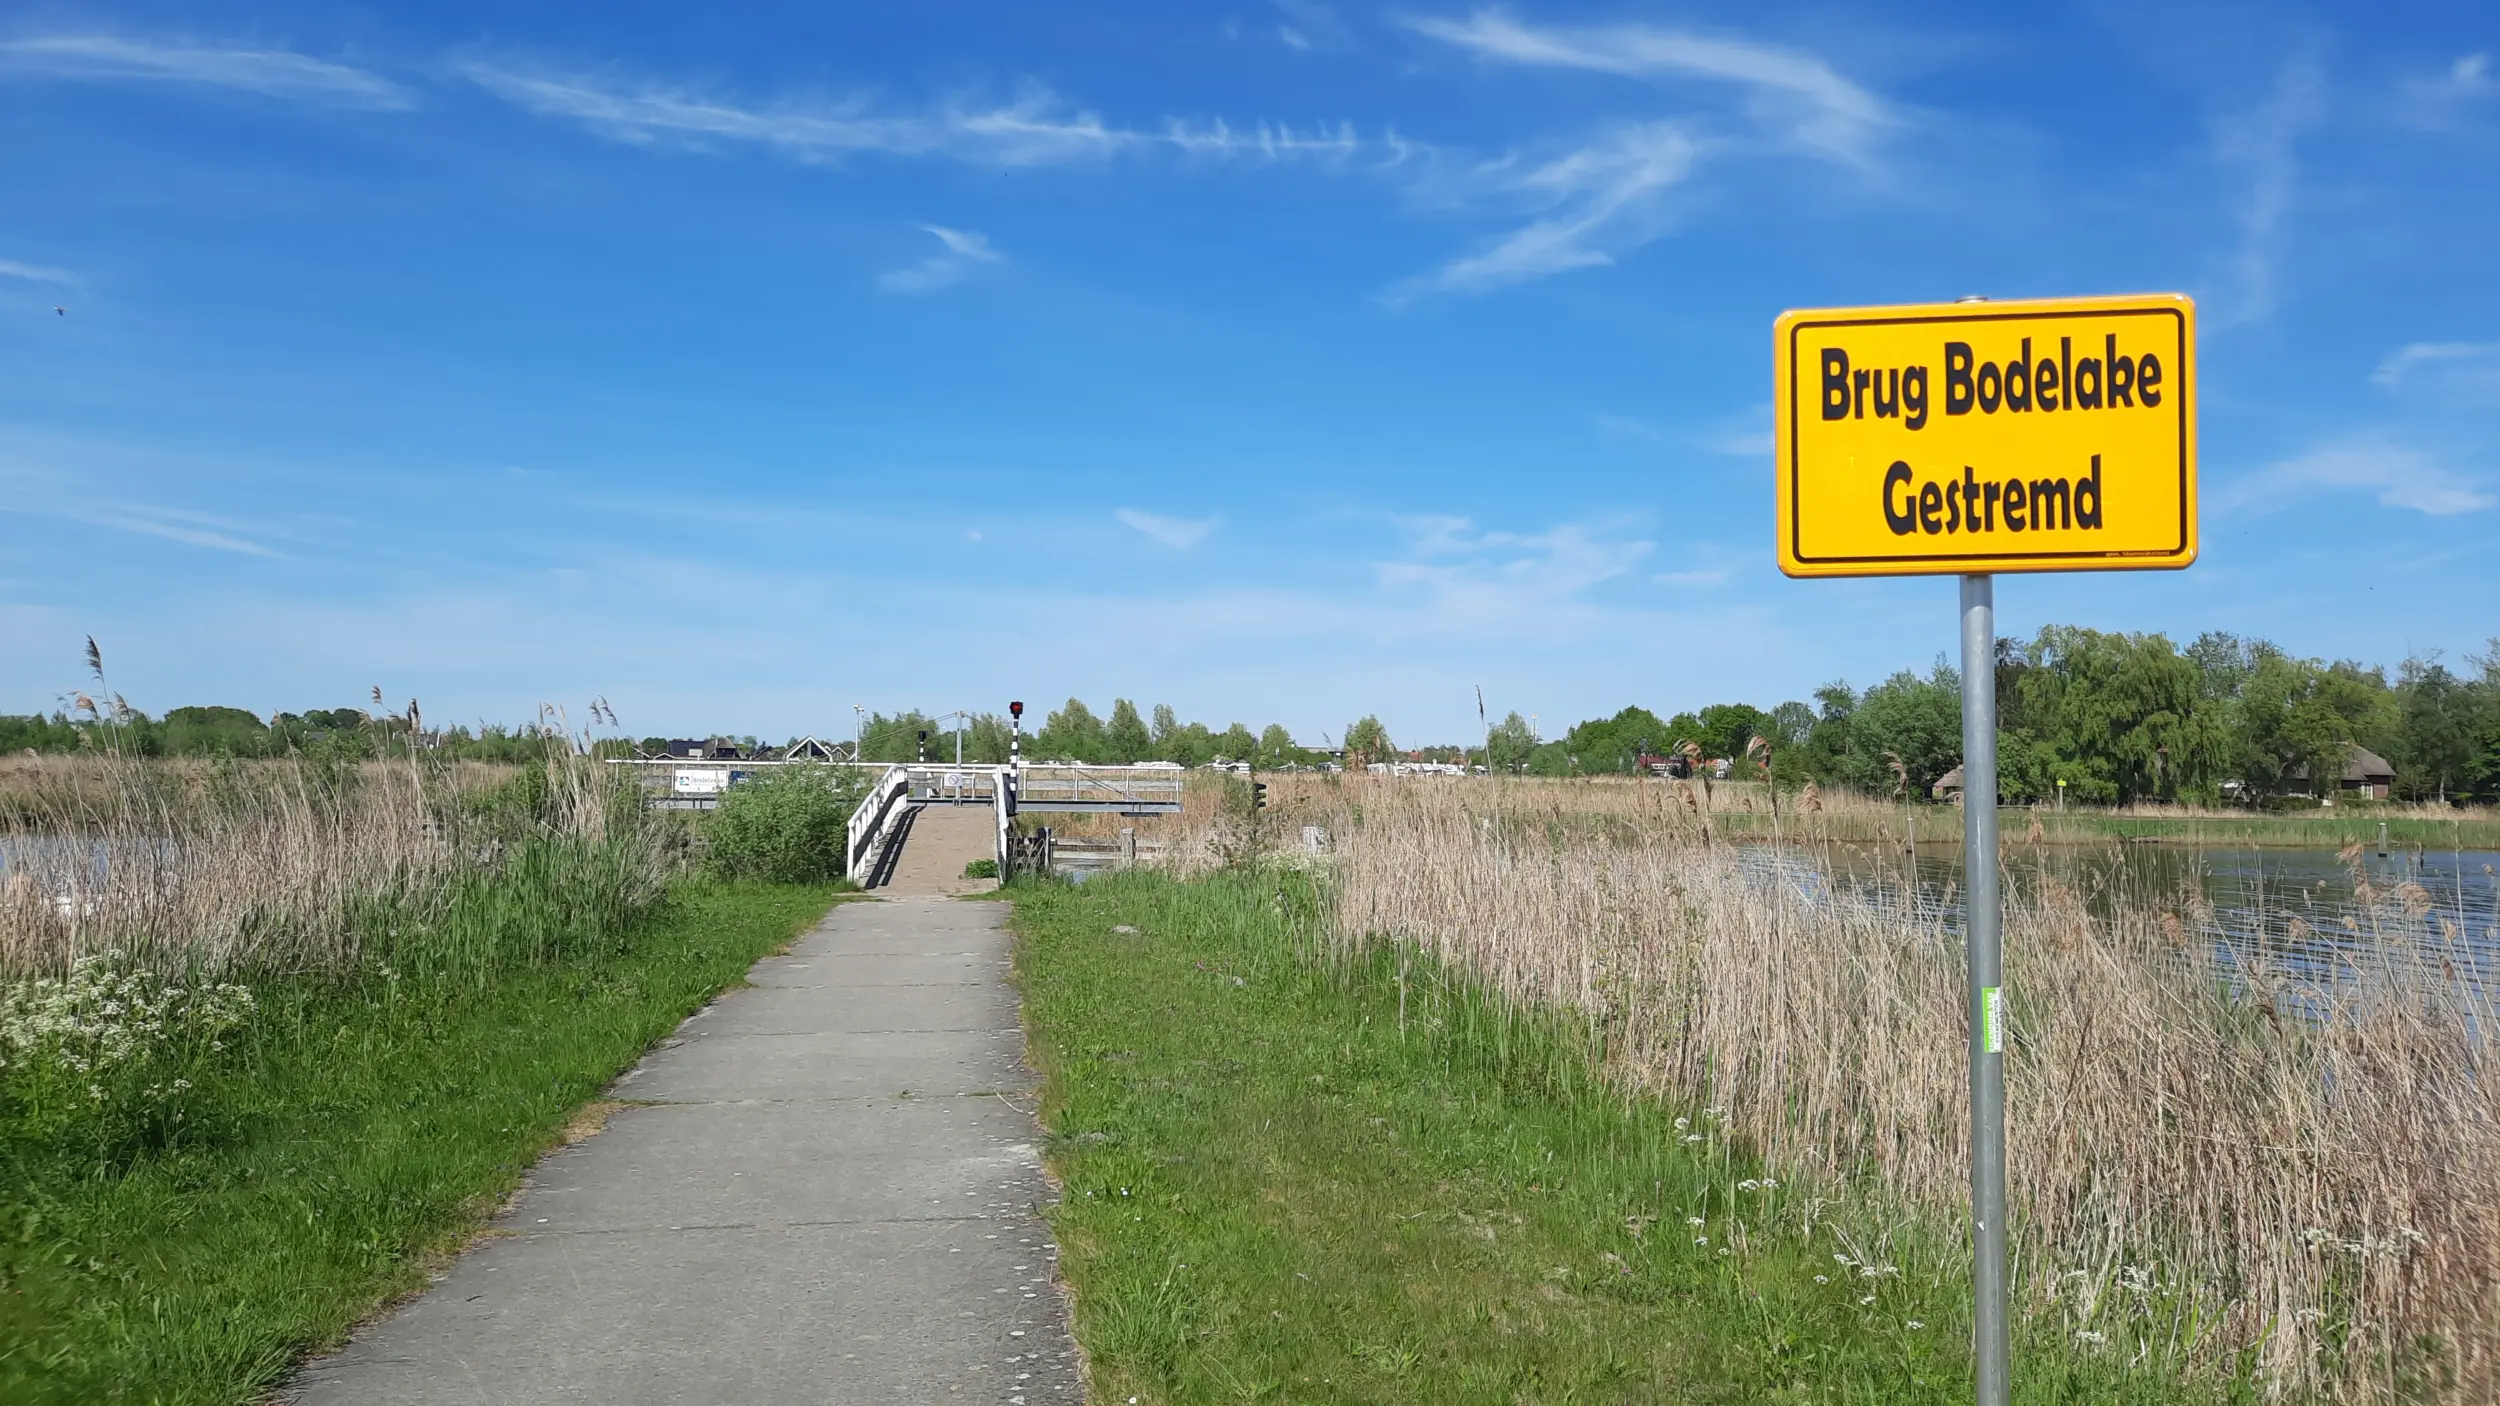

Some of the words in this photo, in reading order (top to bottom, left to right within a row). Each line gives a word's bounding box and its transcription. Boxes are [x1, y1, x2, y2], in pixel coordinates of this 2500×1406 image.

[1820, 347, 1929, 431] Brug
[1944, 333, 2163, 415] Bodelake
[1882, 454, 2103, 536] Gestremd
